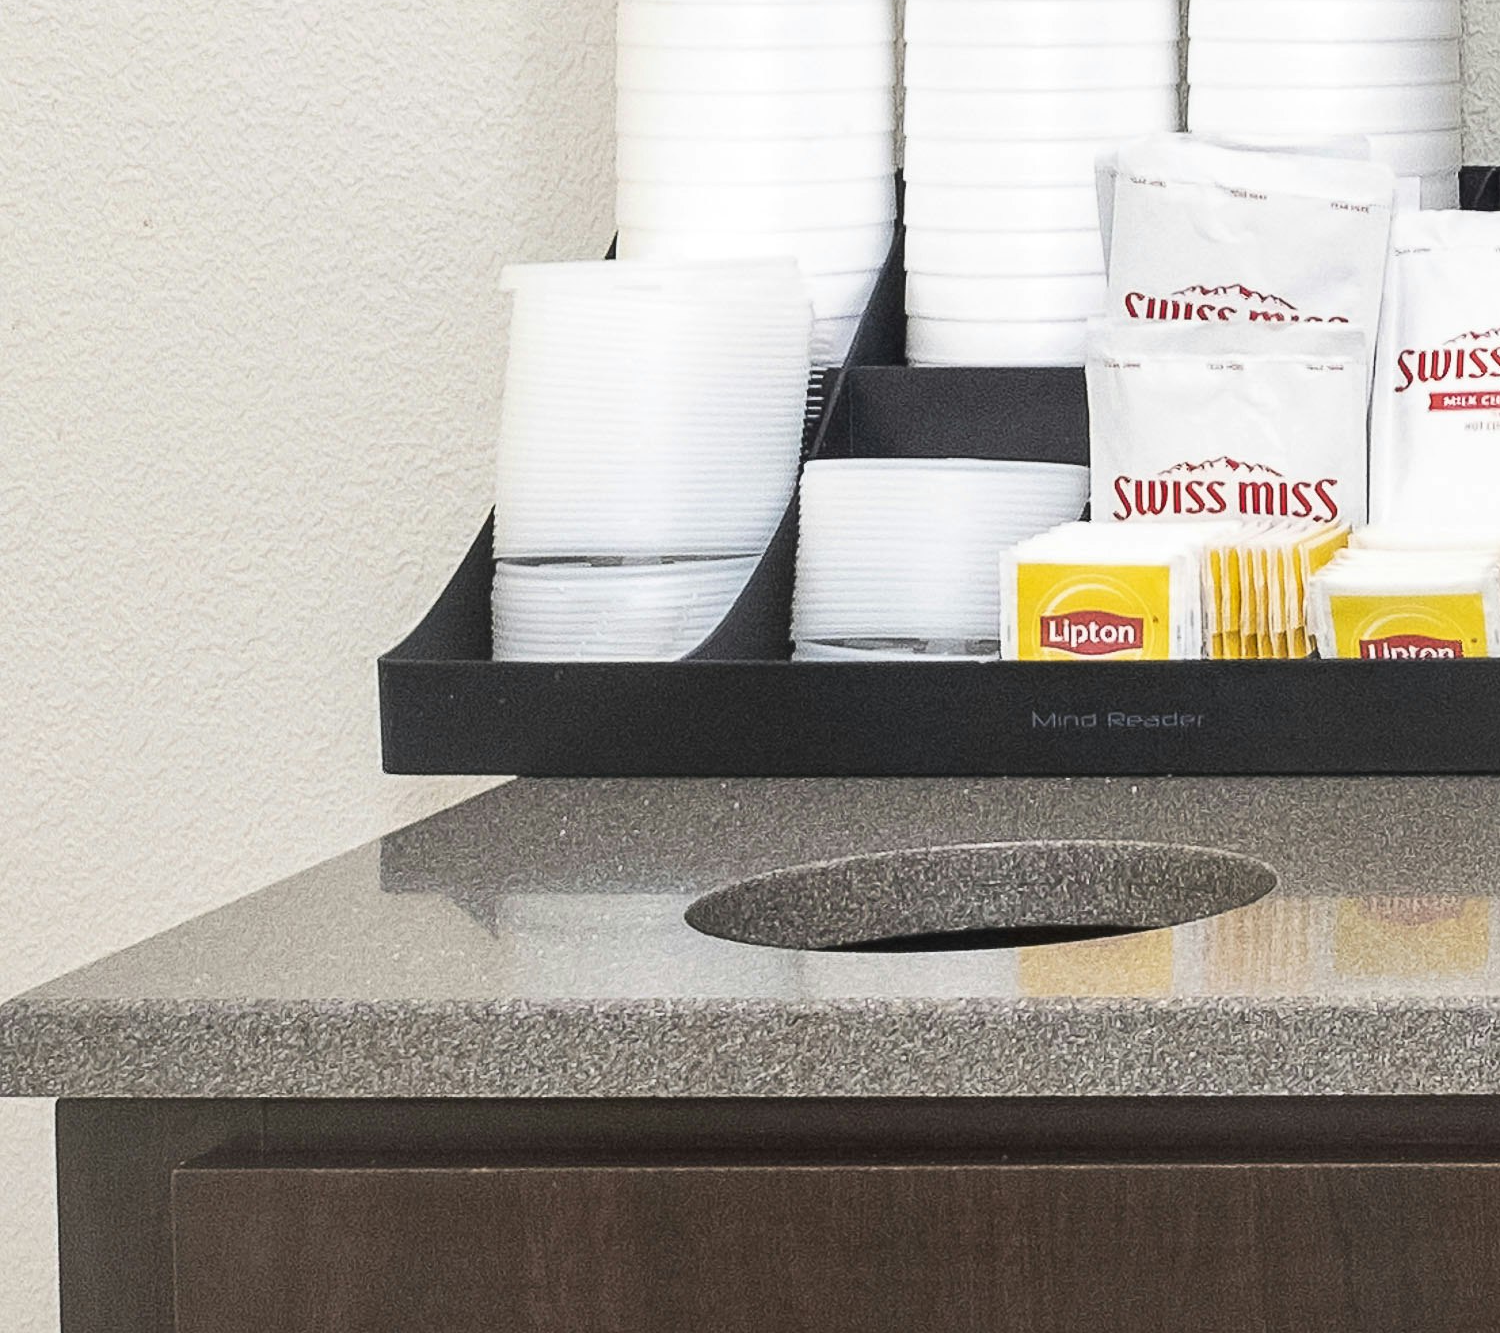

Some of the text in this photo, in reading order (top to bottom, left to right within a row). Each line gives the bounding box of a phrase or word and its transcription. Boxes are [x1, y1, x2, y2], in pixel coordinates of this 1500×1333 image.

[1443, 395, 1477, 407] MILK
[1113, 475, 1227, 521] SWISS
[1049, 619, 1135, 648] Lipton
[1031, 711, 1204, 728] Mind Reader
